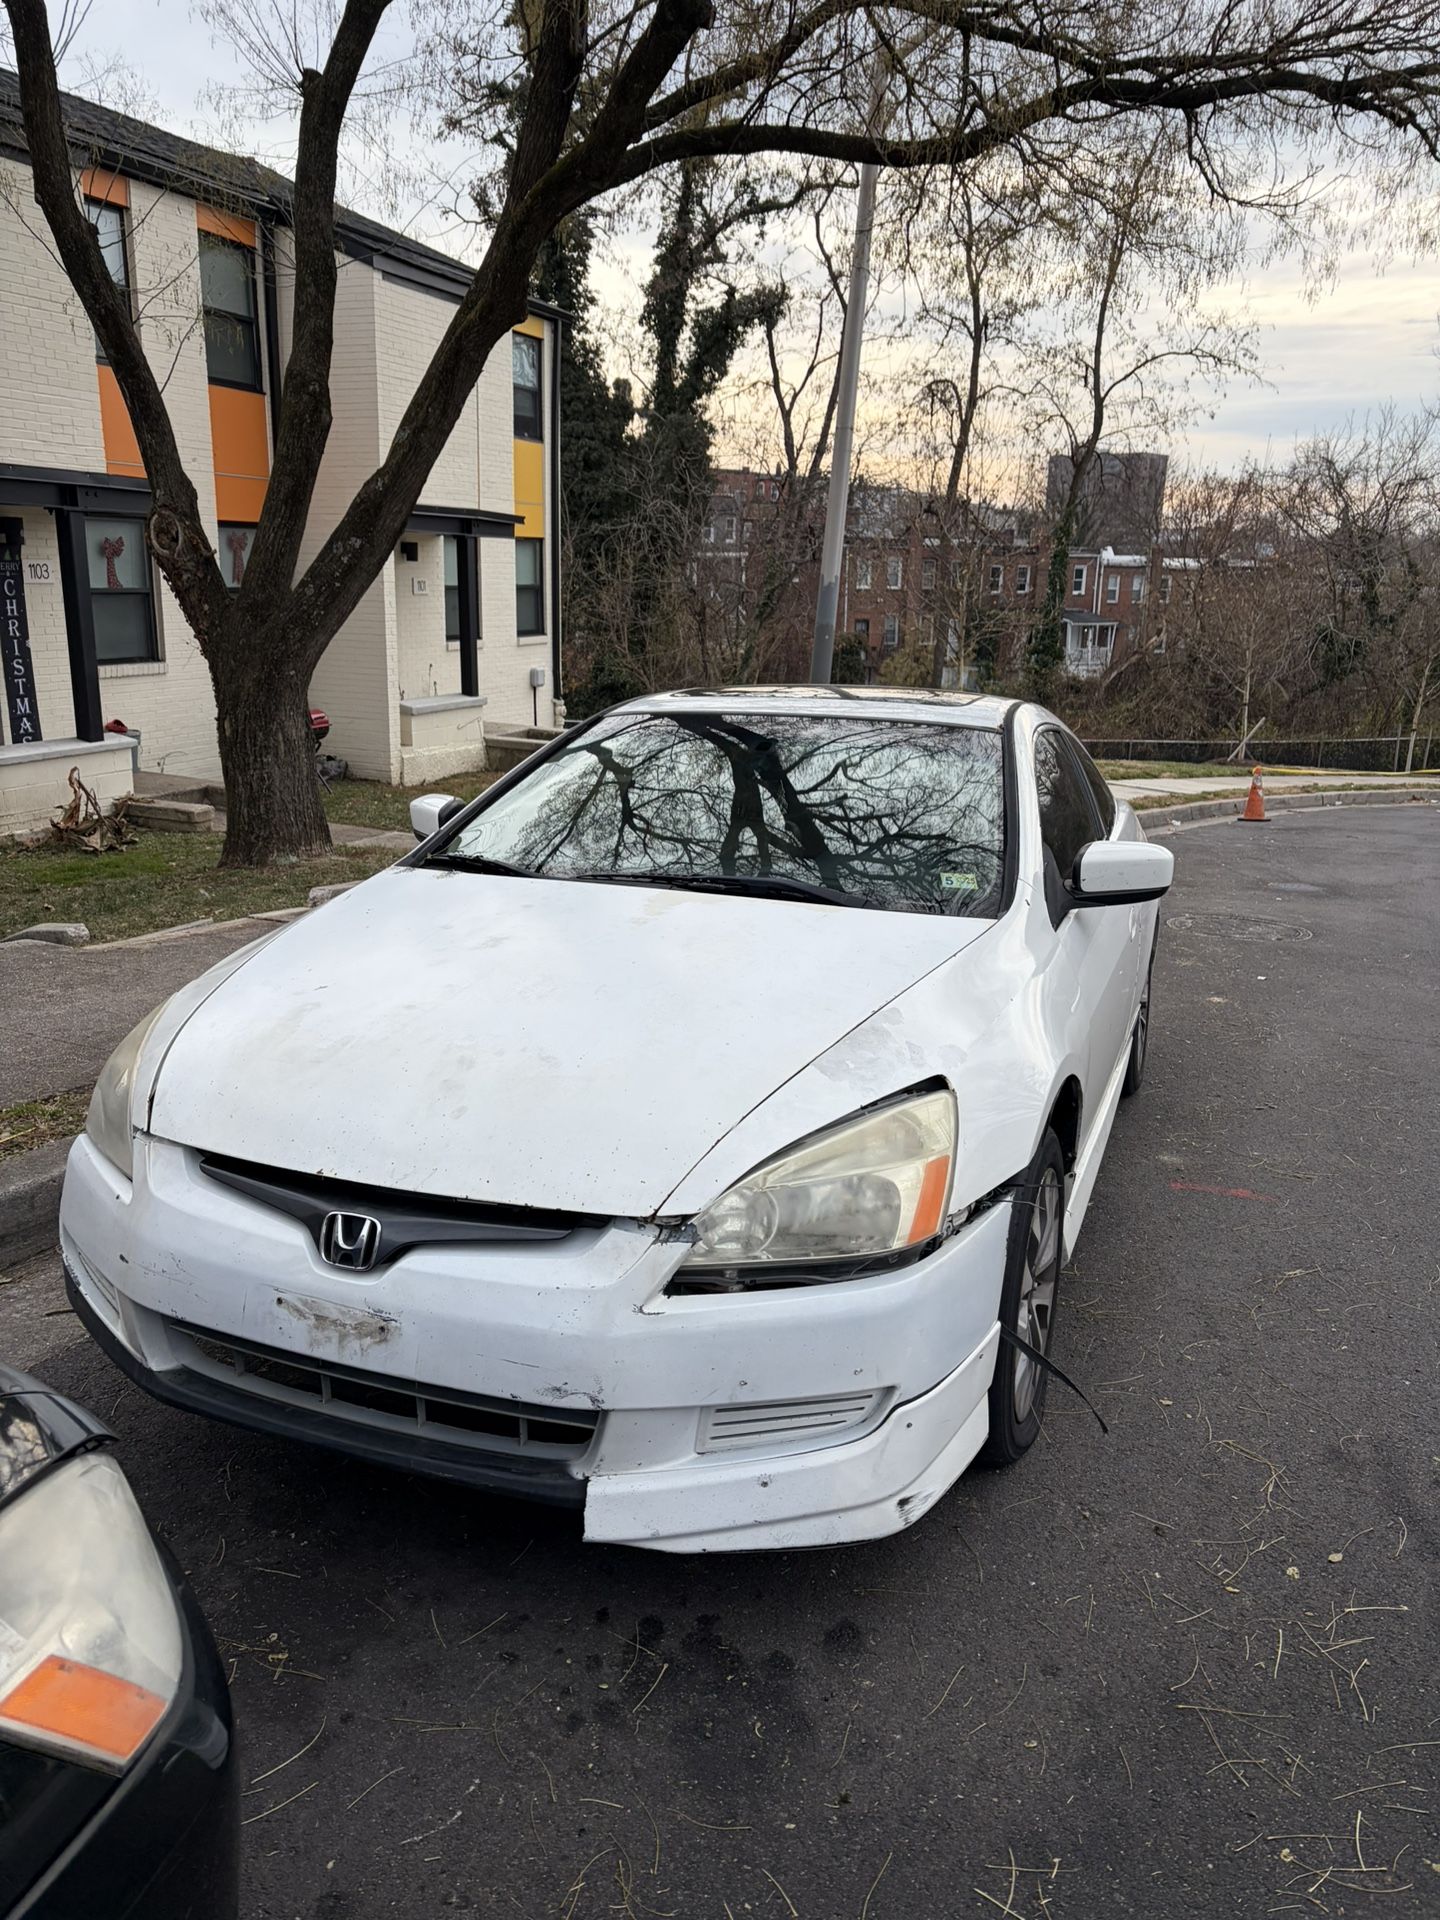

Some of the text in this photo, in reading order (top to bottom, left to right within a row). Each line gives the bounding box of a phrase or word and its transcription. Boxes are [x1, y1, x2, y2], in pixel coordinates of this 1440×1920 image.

[0, 561, 19, 571] ERRY
[28, 563, 49, 579] 1103
[945, 876, 954, 885] 5
